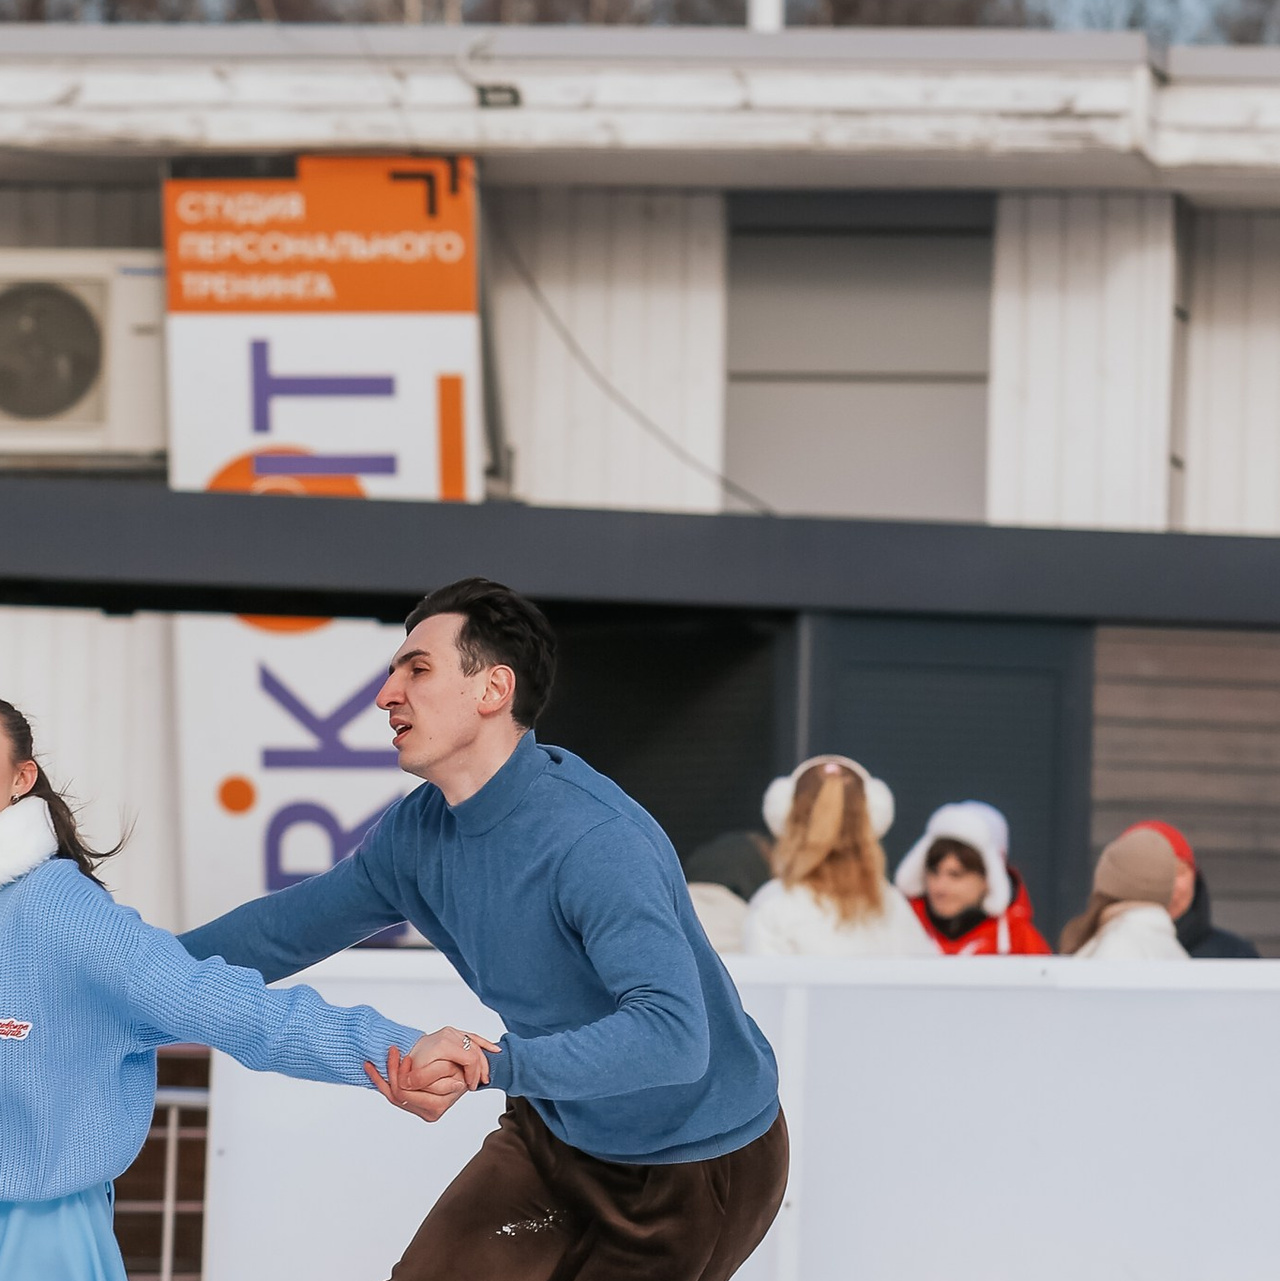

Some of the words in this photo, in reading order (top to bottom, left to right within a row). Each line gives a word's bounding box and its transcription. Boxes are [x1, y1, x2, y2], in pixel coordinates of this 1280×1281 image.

[176, 191, 305, 225] СТУДИЯ
[178, 231, 465, 264] ПЕРСОНАЛЬНОГО
[180, 270, 335, 302] ТРЕНИНГА
